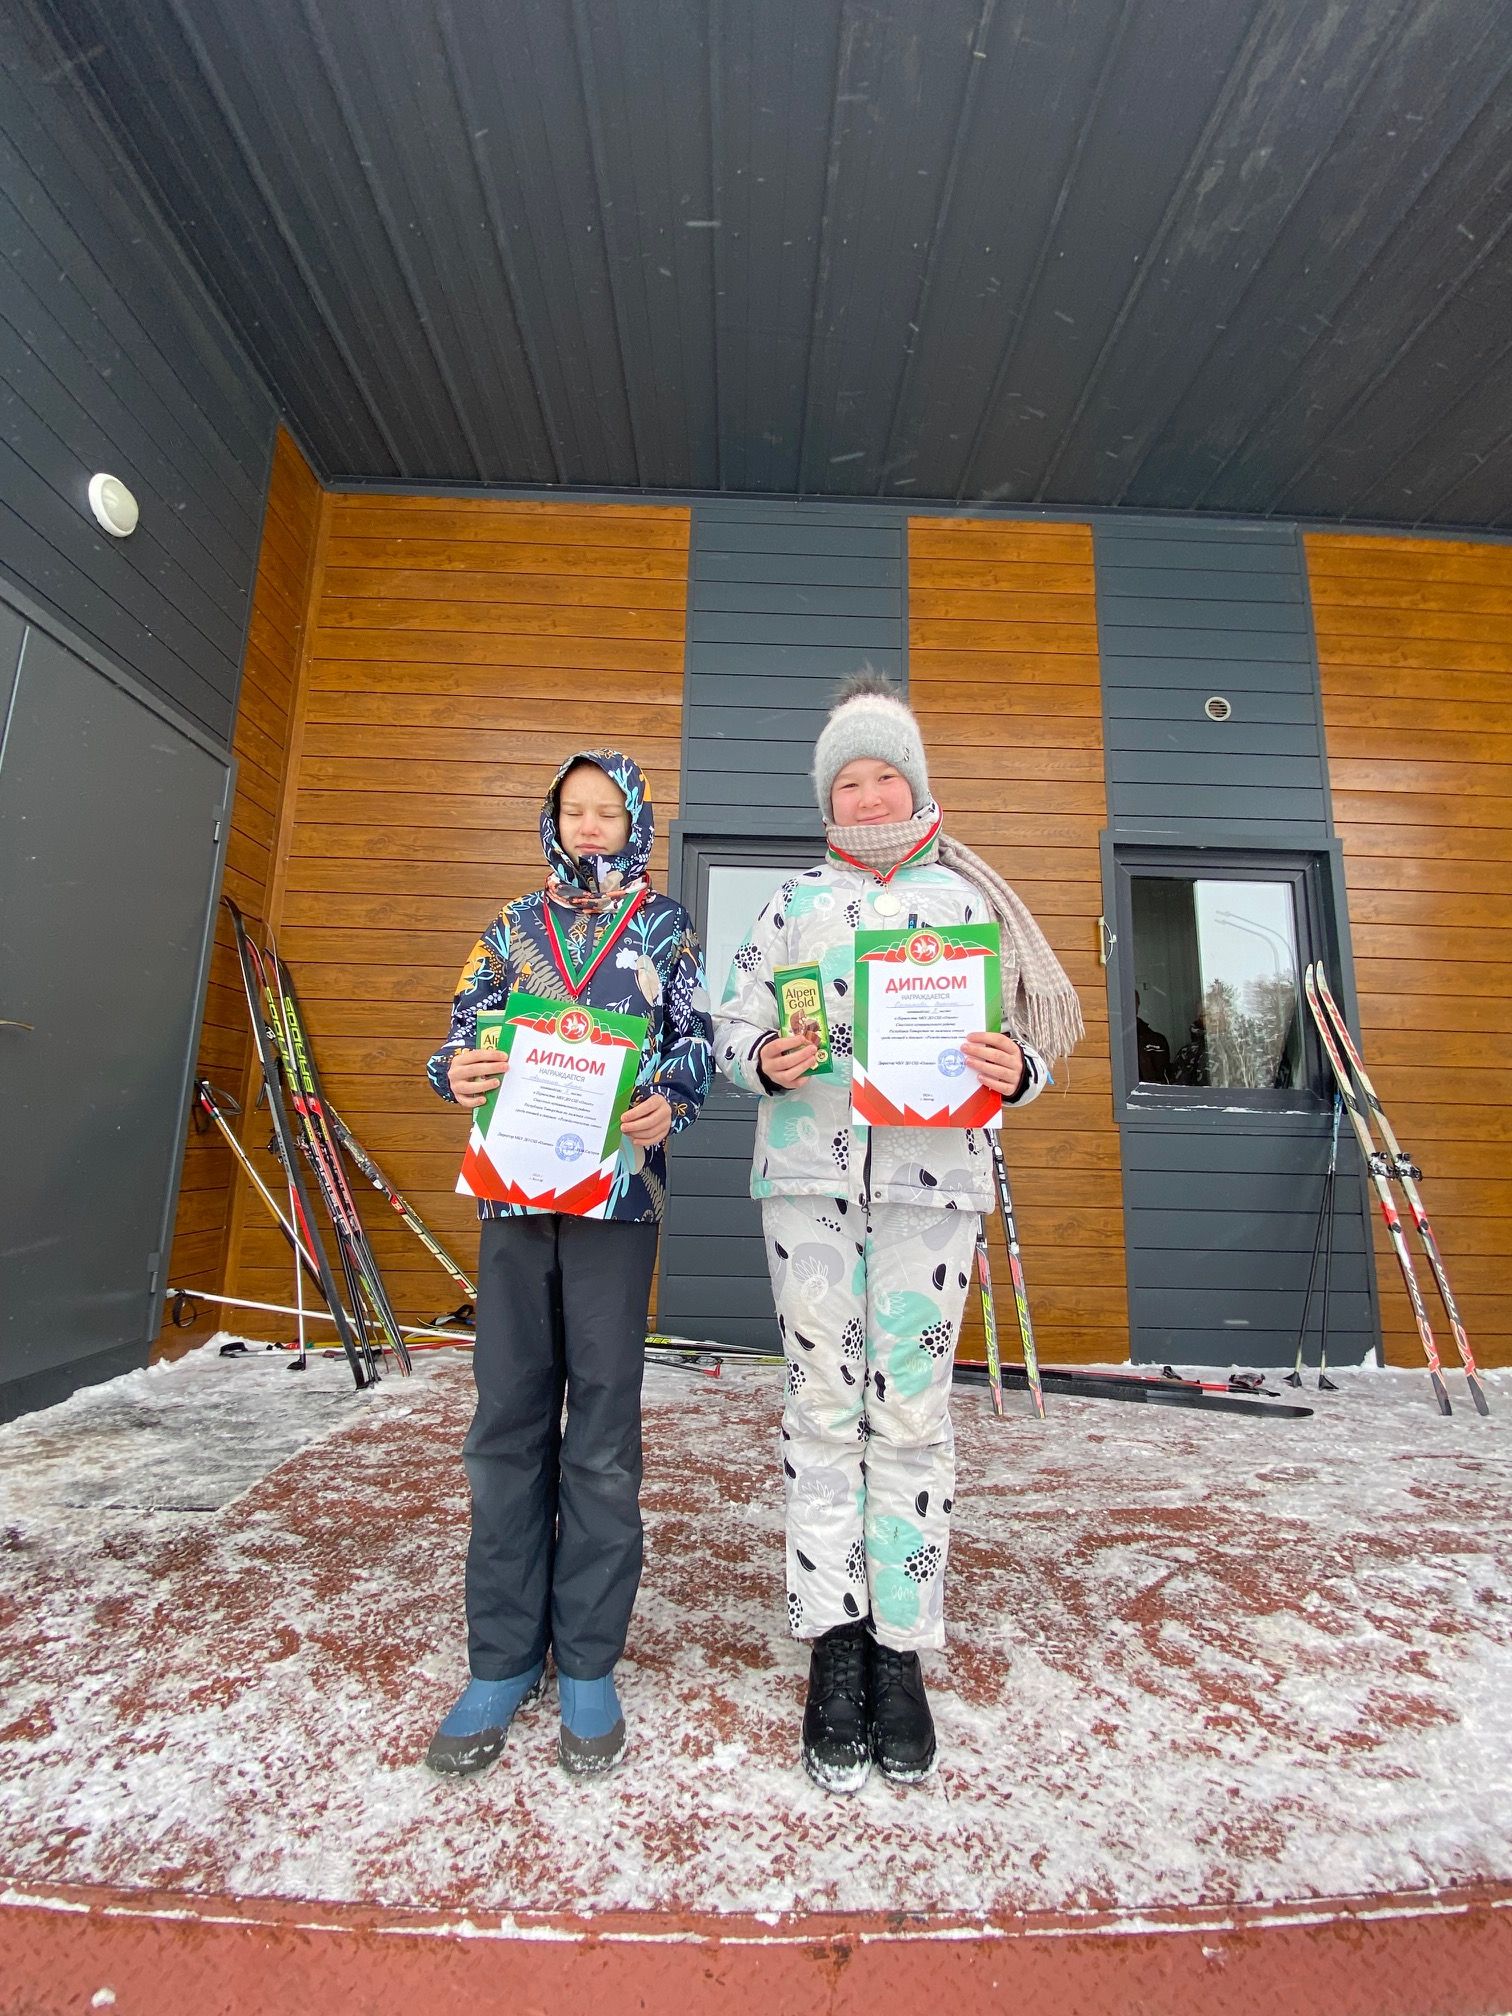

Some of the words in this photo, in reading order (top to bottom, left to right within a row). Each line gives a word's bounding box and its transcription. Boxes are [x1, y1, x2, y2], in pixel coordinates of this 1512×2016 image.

[885, 975, 967, 993] ДИПЛОМ
[785, 987, 816, 1000] Alpen
[788, 996, 815, 1009] Gold
[525, 1048, 605, 1076] ДИПЛОМ
[538, 1067, 585, 1083] НАГРАЖДАЕТСЯ
[1436, 1262, 1458, 1320] TOUR
[981, 1290, 998, 1378] SKATE
